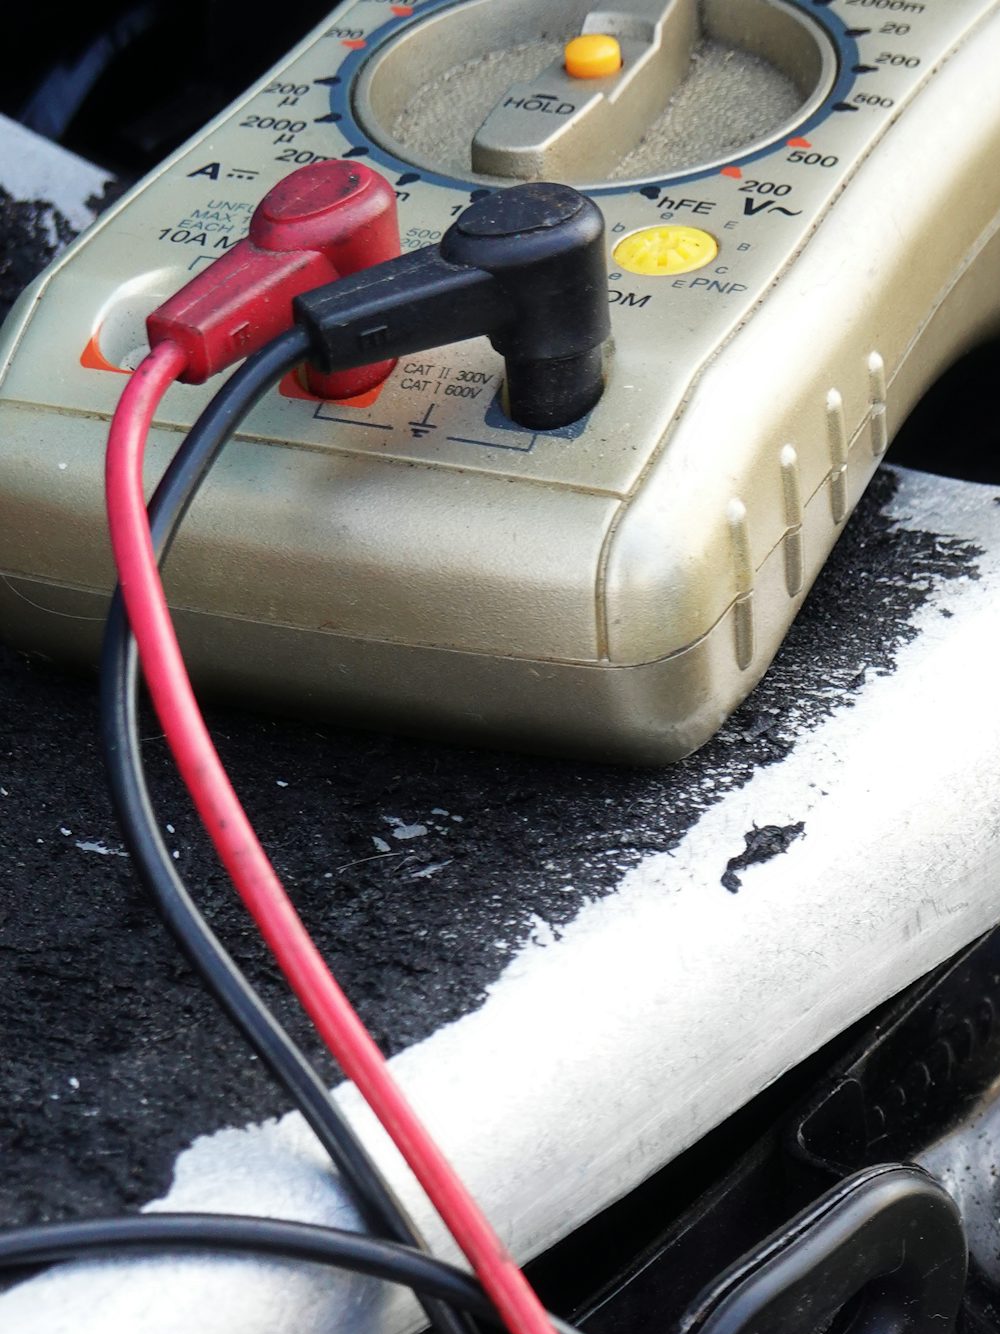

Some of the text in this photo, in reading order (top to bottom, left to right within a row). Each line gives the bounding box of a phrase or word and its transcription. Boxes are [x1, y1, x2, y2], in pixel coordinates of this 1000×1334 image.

[326, 29, 364, 39] 200
[879, 22, 911, 35] 20
[874, 53, 921, 68] 200
[265, 83, 310, 96] 200
[503, 97, 576, 115] HOLD
[853, 93, 895, 108] 500
[239, 115, 307, 133] 2000
[786, 151, 840, 167] 500
[738, 180, 793, 197] 200
[656, 196, 717, 215] hFE
[190, 209, 234, 222] MAX
[177, 219, 235, 234] EACH
[611, 222, 626, 233] b
[723, 220, 739, 230] E
[158, 228, 207, 246] 10A
[406, 227, 442, 240] 500
[736, 242, 751, 252] B
[671, 279, 687, 289] E
[688, 278, 749, 295] PNP
[403, 363, 435, 376] CAT
[455, 370, 495, 385] 300V
[400, 378, 432, 391] CAT
[444, 385, 483, 399] 600V
